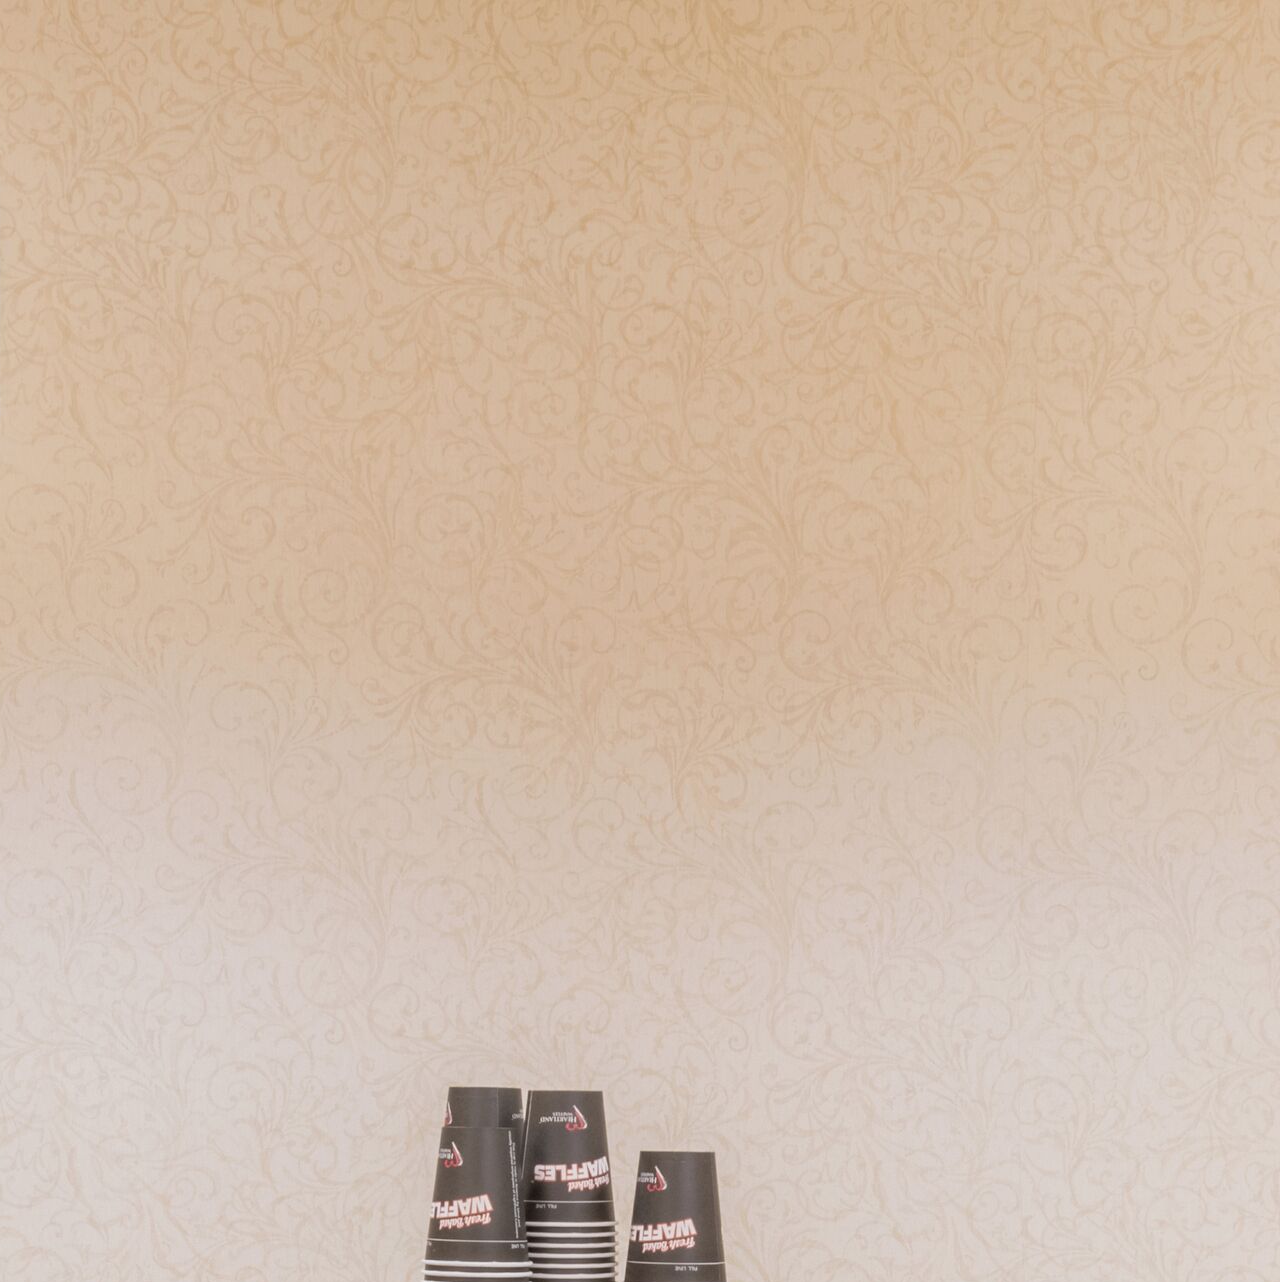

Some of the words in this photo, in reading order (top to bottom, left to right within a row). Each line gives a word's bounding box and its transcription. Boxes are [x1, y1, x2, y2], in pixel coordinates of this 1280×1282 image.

[534, 1156, 609, 1181] WAFFLES
[568, 1178, 596, 1192] Baked
[465, 1212, 492, 1226] Fresh
[642, 1240, 669, 1253] Baked
[669, 1236, 696, 1250] Fresh
